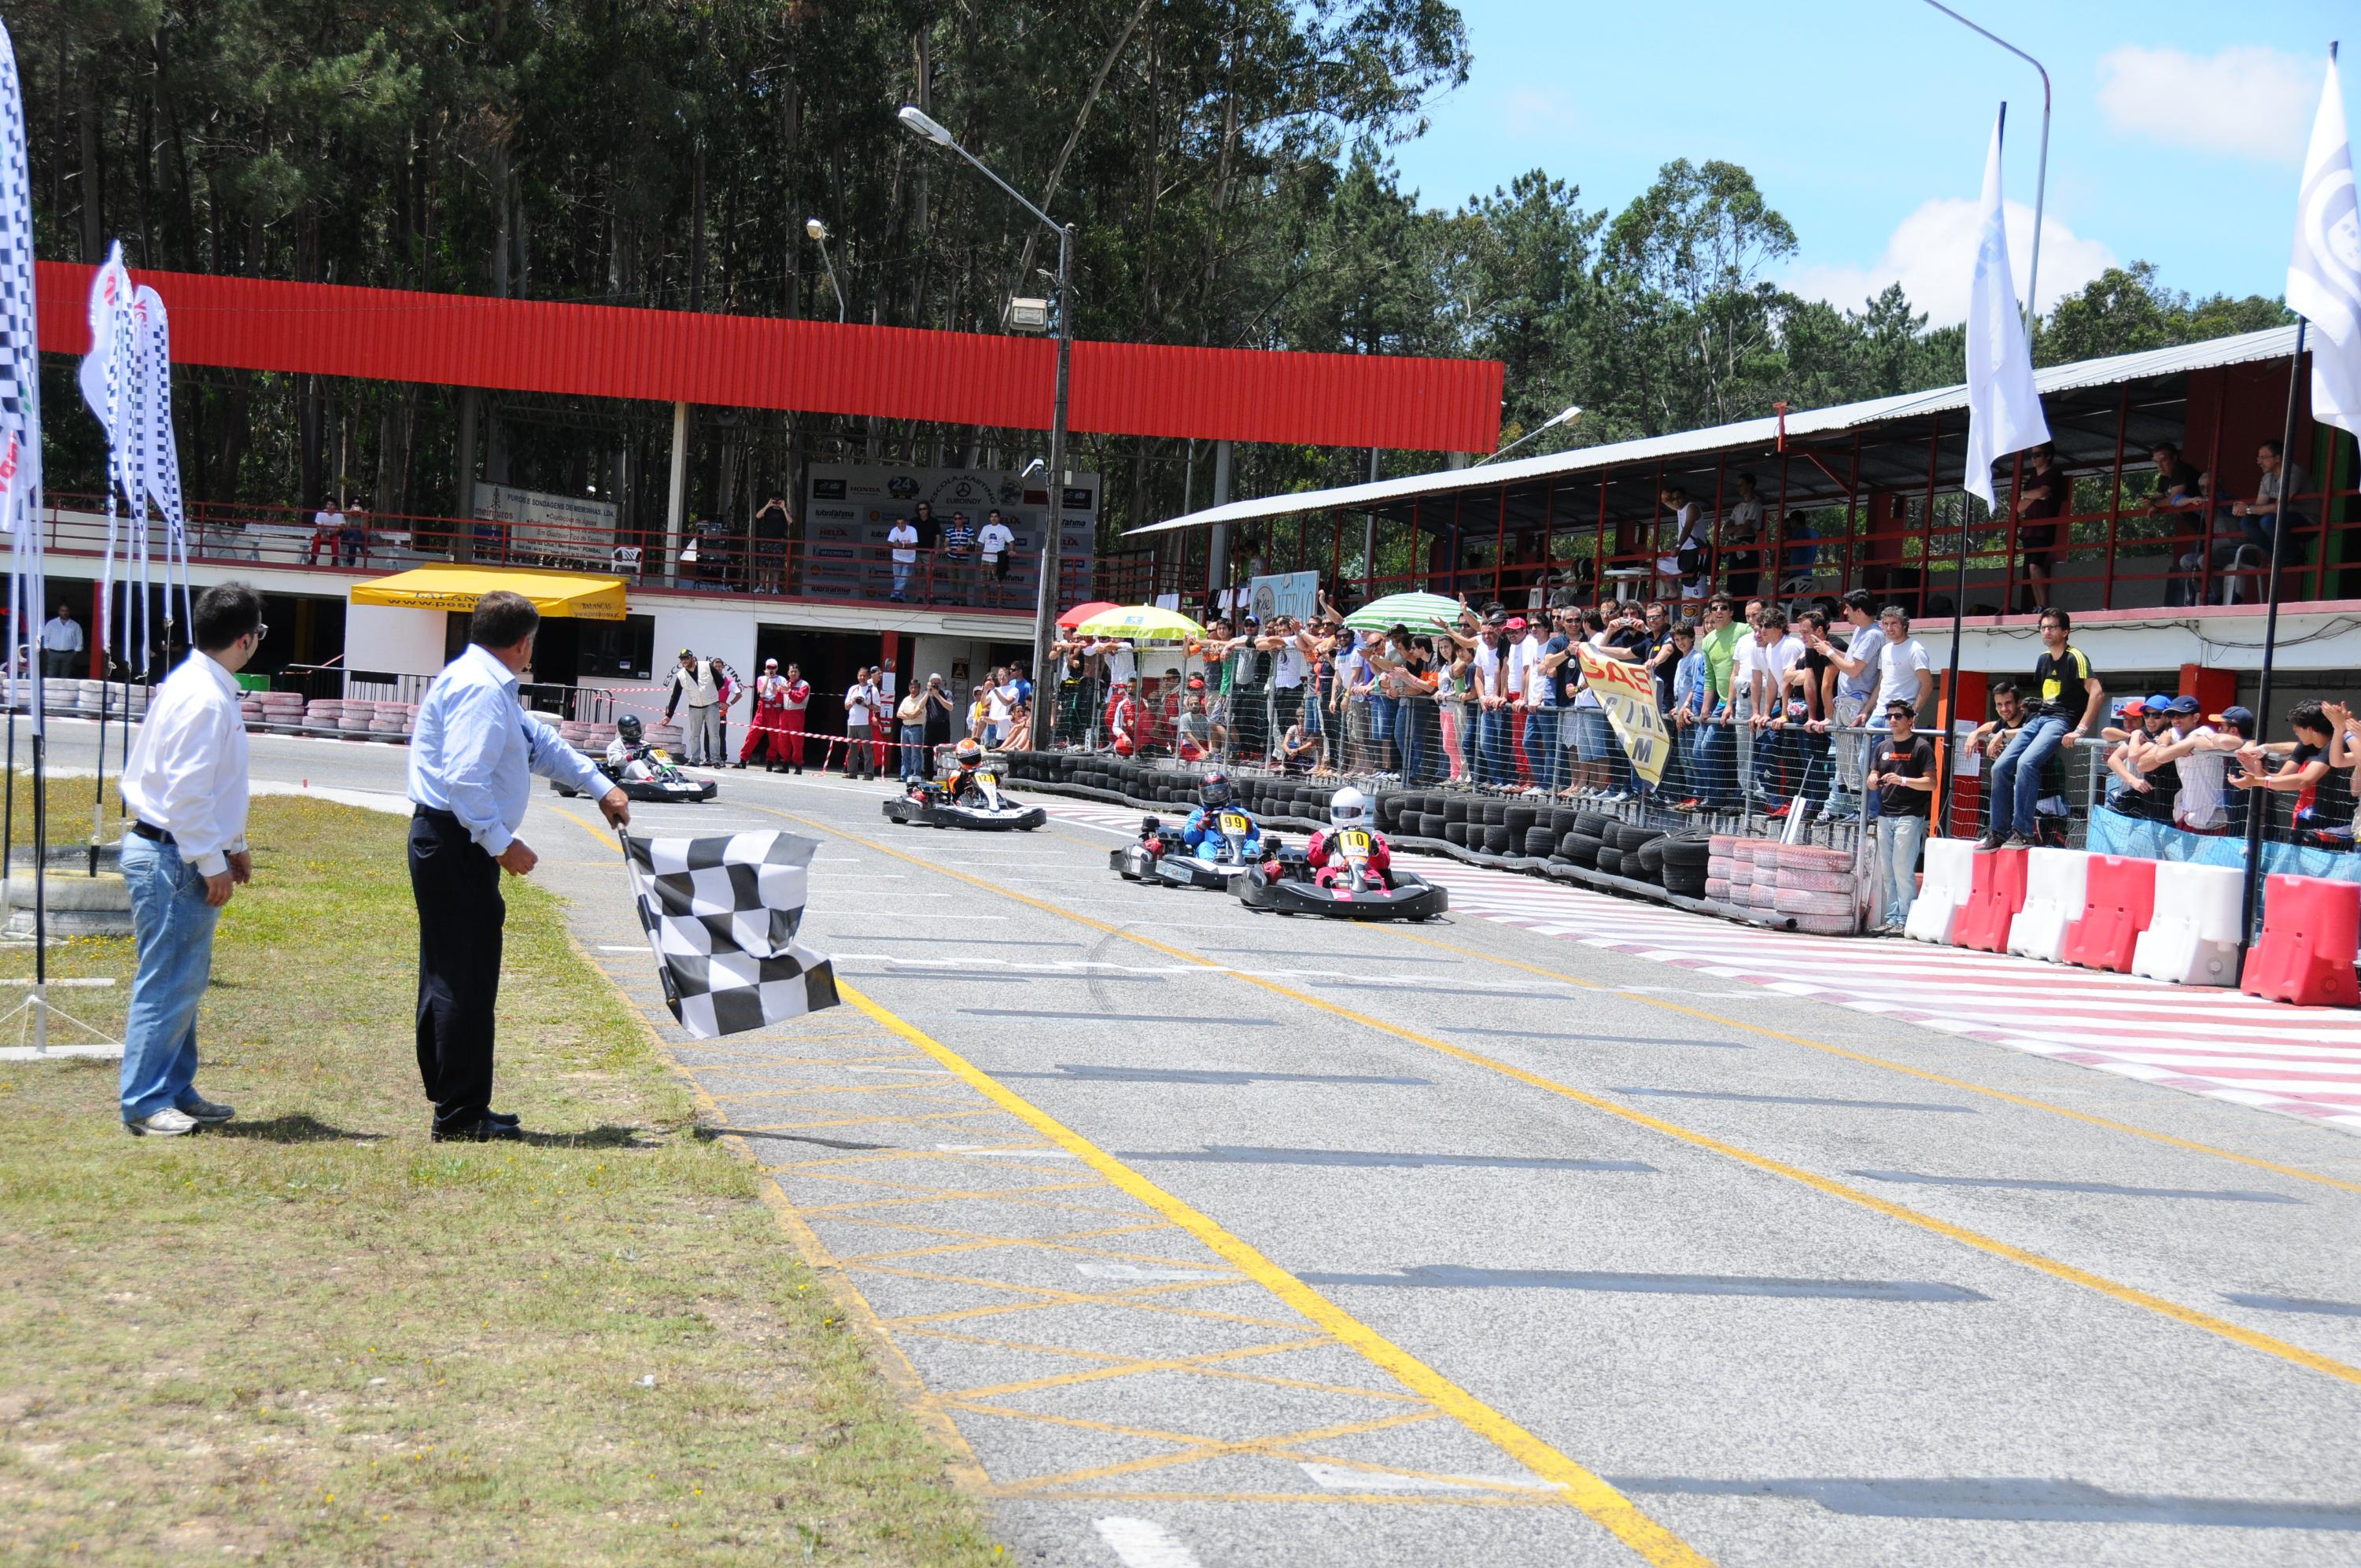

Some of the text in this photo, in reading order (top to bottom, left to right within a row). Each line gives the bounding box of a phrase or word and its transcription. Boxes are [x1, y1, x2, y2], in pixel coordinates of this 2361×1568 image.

[930, 475, 958, 503] ESCOLA
[963, 474, 996, 504] KARTING
[583, 546, 601, 555] POMBAL
[1224, 816, 1241, 828] 99
[1345, 833, 1364, 846] 10
